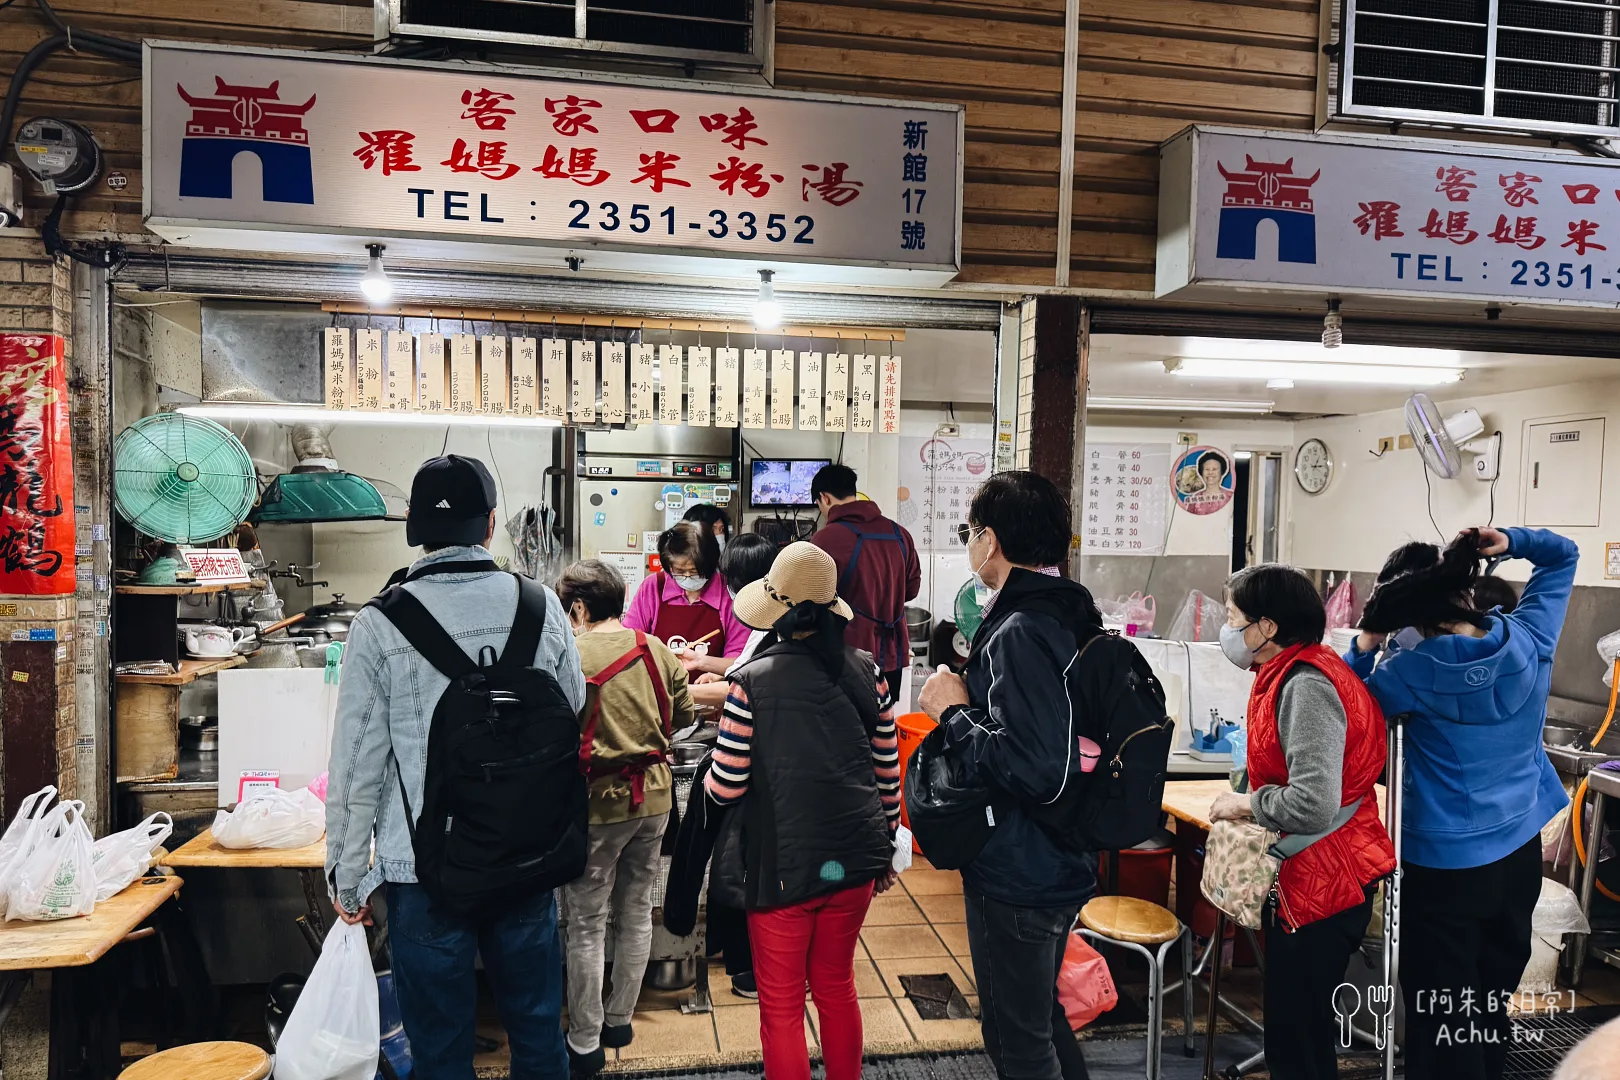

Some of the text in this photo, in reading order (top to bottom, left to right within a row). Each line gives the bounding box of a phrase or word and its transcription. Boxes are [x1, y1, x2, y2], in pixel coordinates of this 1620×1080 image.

[460, 87, 768, 150] 客家口味
[352, 129, 864, 207] 羅媽媽米粉湯
[900, 119, 929, 251] 新館17號
[1434, 165, 1620, 207] 客家口
[567, 199, 815, 245] 2351-3352
[1352, 200, 1608, 256] 羅媽媽米
[1510, 259, 1620, 290] 2351-
[330, 334, 345, 411] 羅媽媽米粉湯
[365, 338, 379, 408] 米粉湯
[396, 341, 411, 410] 脆骨
[428, 343, 443, 411] 豬肺
[460, 344, 473, 413] 生腸
[490, 345, 504, 414] 粉腸
[521, 347, 534, 415] 嘴邊肉
[550, 349, 564, 417] 肝連
[580, 351, 594, 418] 豬舌
[610, 352, 623, 417] 豬心
[638, 353, 651, 420] 豬小肚
[667, 354, 679, 421] 白管
[696, 356, 708, 422] 黑管
[724, 357, 736, 423] 豬皮
[751, 358, 764, 425] 燙青菜
[779, 359, 792, 426] 大腸
[806, 362, 819, 427] 油豆腐
[833, 362, 846, 428] 大腸頭
[860, 364, 873, 428] 黑白切
[883, 361, 897, 433] 請先排隊點餐
[1130, 476, 1153, 485] 30/50
[1131, 451, 1141, 459] 60
[1131, 464, 1141, 472] 40
[1129, 503, 1139, 511] 40
[1129, 515, 1139, 523] 30
[1130, 490, 1140, 498] 40
[1128, 540, 1142, 549] 120
[1129, 528, 1138, 536] 30
